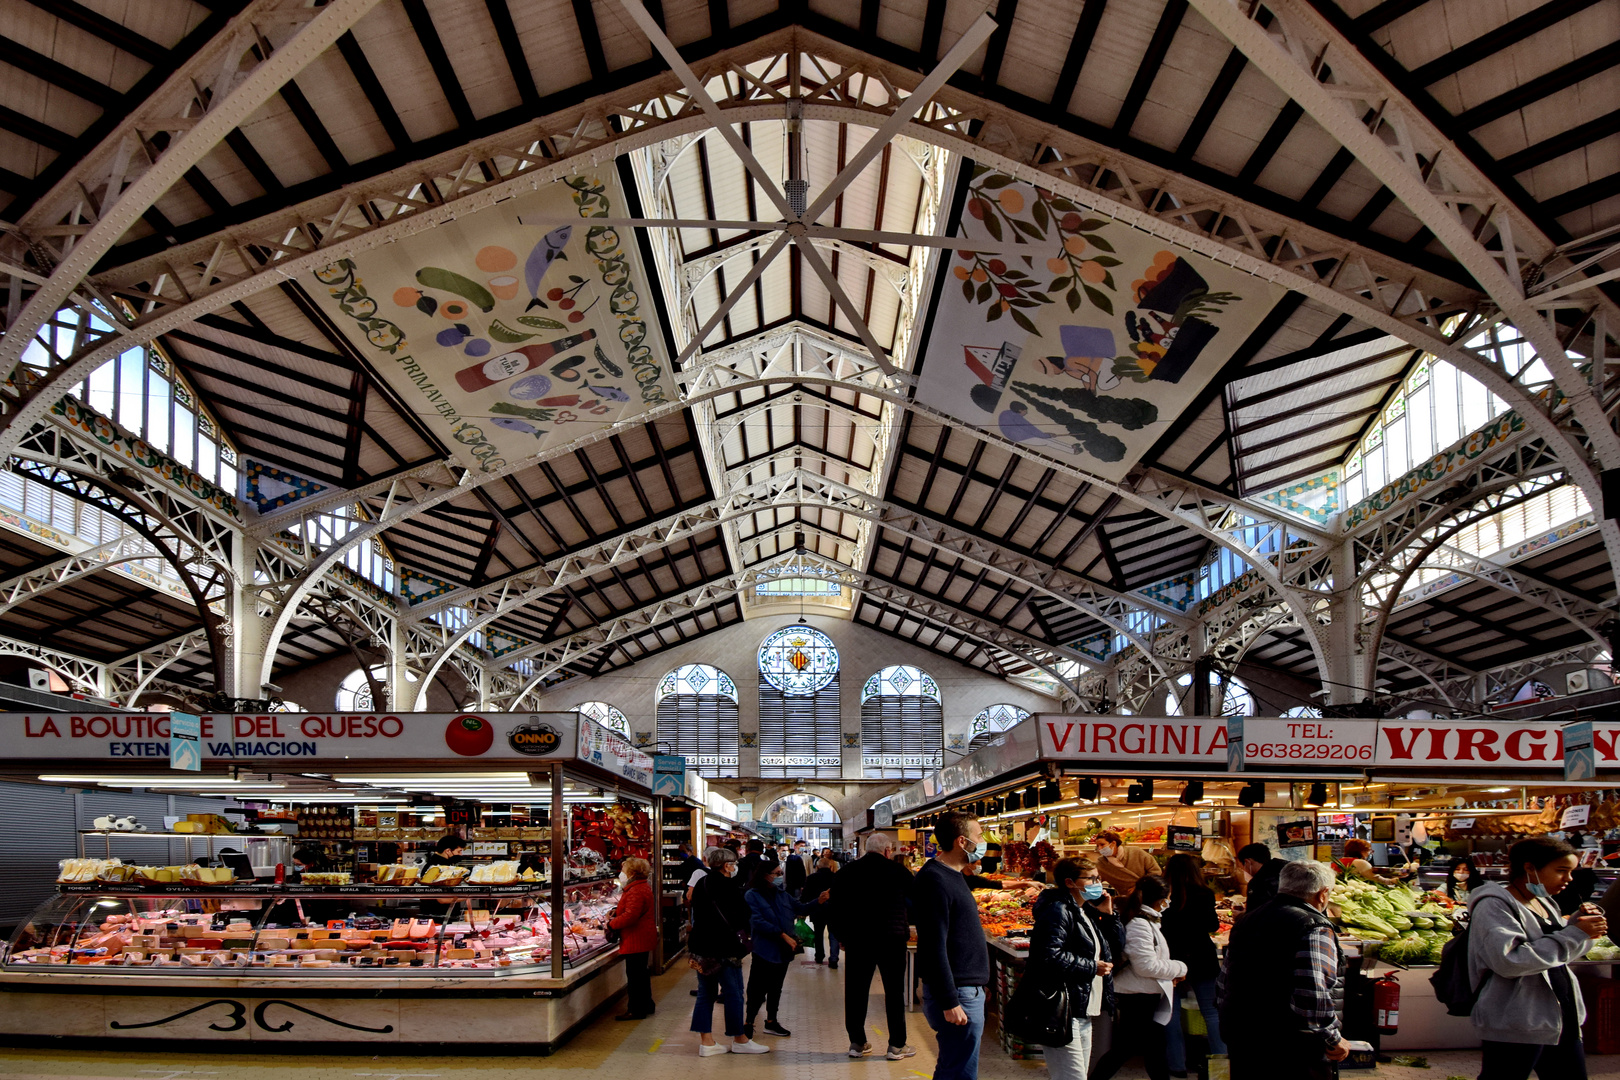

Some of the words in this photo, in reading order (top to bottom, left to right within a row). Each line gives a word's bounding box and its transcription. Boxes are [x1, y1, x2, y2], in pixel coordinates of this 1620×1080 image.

[499, 357, 515, 376] TURIA
[395, 355, 461, 425] PRIMAVERA
[25, 716, 62, 738] LA
[71, 716, 214, 738] BOUTIQE
[235, 716, 285, 738] DEL
[300, 715, 404, 738] QUESO
[1287, 723, 1334, 739] TEL:
[514, 733, 555, 744] ONNO
[1046, 723, 1228, 755] VIRGINIA
[208, 742, 316, 756] VARIACION
[1245, 743, 1372, 760] 963829206
[451, 811, 468, 822] 04
